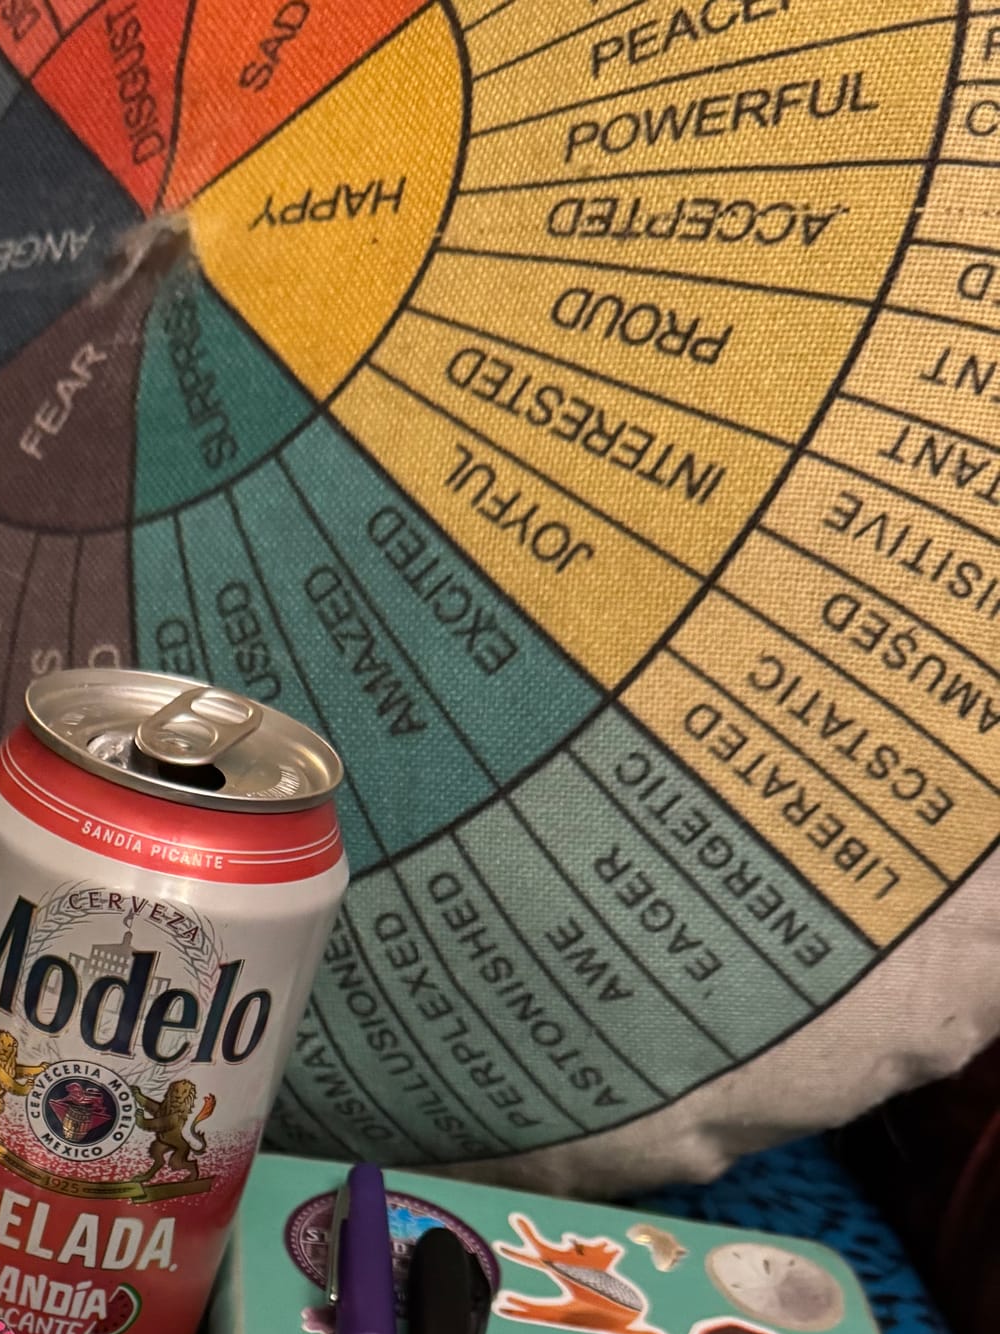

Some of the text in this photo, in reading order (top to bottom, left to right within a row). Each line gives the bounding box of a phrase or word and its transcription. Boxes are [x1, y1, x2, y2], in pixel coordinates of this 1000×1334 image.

[106, 3, 167, 166] DISGUST
[238, 0, 311, 92] SAD
[590, 0, 788, 80] PEACE
[564, 71, 880, 163] POWERFUL
[248, 176, 407, 231] HAPPY
[547, 197, 850, 247] ACCEPTED
[550, 286, 733, 366] PROUD
[19, 342, 107, 460] FEAR
[445, 346, 725, 501] INTERESTED
[444, 443, 595, 574] JOYFUL
[366, 505, 518, 677] EXCITED
[303, 564, 427, 737] AMAZED
[821, 590, 1000, 736] AMUSED
[745, 653, 953, 827] ECSTATIC
[80, 819, 224, 871] SANDÍA PICANTE
[614, 751, 832, 969] ENERGETIC
[682, 702, 900, 900] LIBERATED
[68, 891, 202, 943] CERVEZA
[544, 919, 634, 1003] AWE
[593, 846, 723, 984] EAGER
[374, 911, 543, 1129] PERPLEXED
[428, 871, 626, 1108] ASTONISHED
[30, 1064, 133, 1142] CERVECERIA MODELO
[41, 1132, 104, 1158] MEXICO
[44, 1175, 80, 1194] 1925
